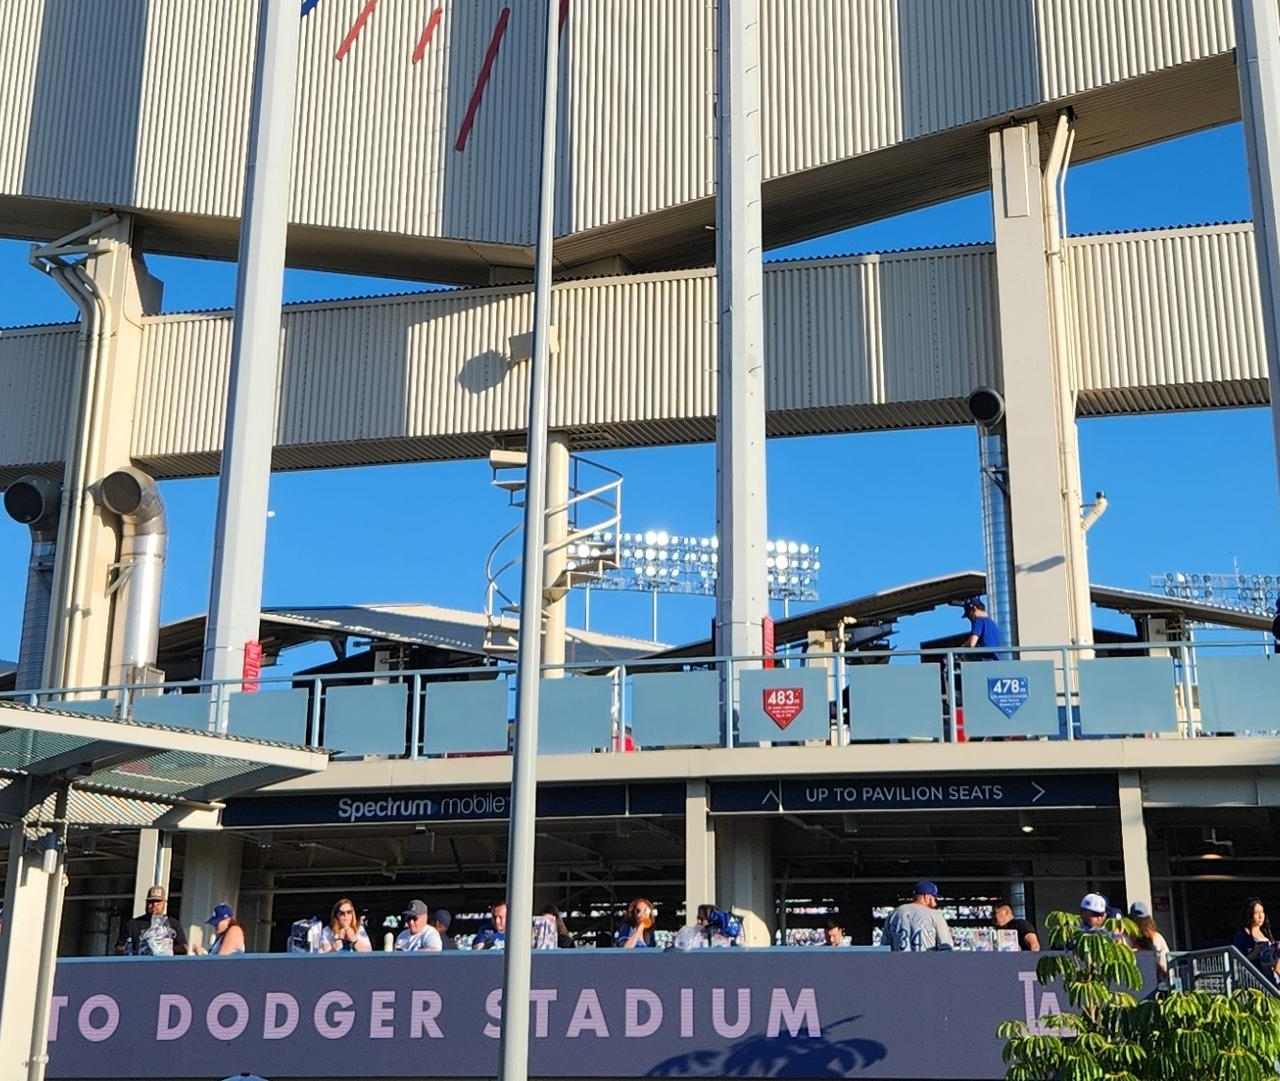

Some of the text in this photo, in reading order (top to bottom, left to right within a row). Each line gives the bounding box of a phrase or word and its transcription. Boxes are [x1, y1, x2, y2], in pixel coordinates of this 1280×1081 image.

[993, 679, 1019, 694] 478
[768, 690, 794, 705] 483
[805, 784, 1003, 802] UP TO PAVILION SEATS
[338, 793, 505, 822] Spectrum mobile
[156, 990, 445, 1040] DODGER
[483, 987, 822, 1038] STADIUM
